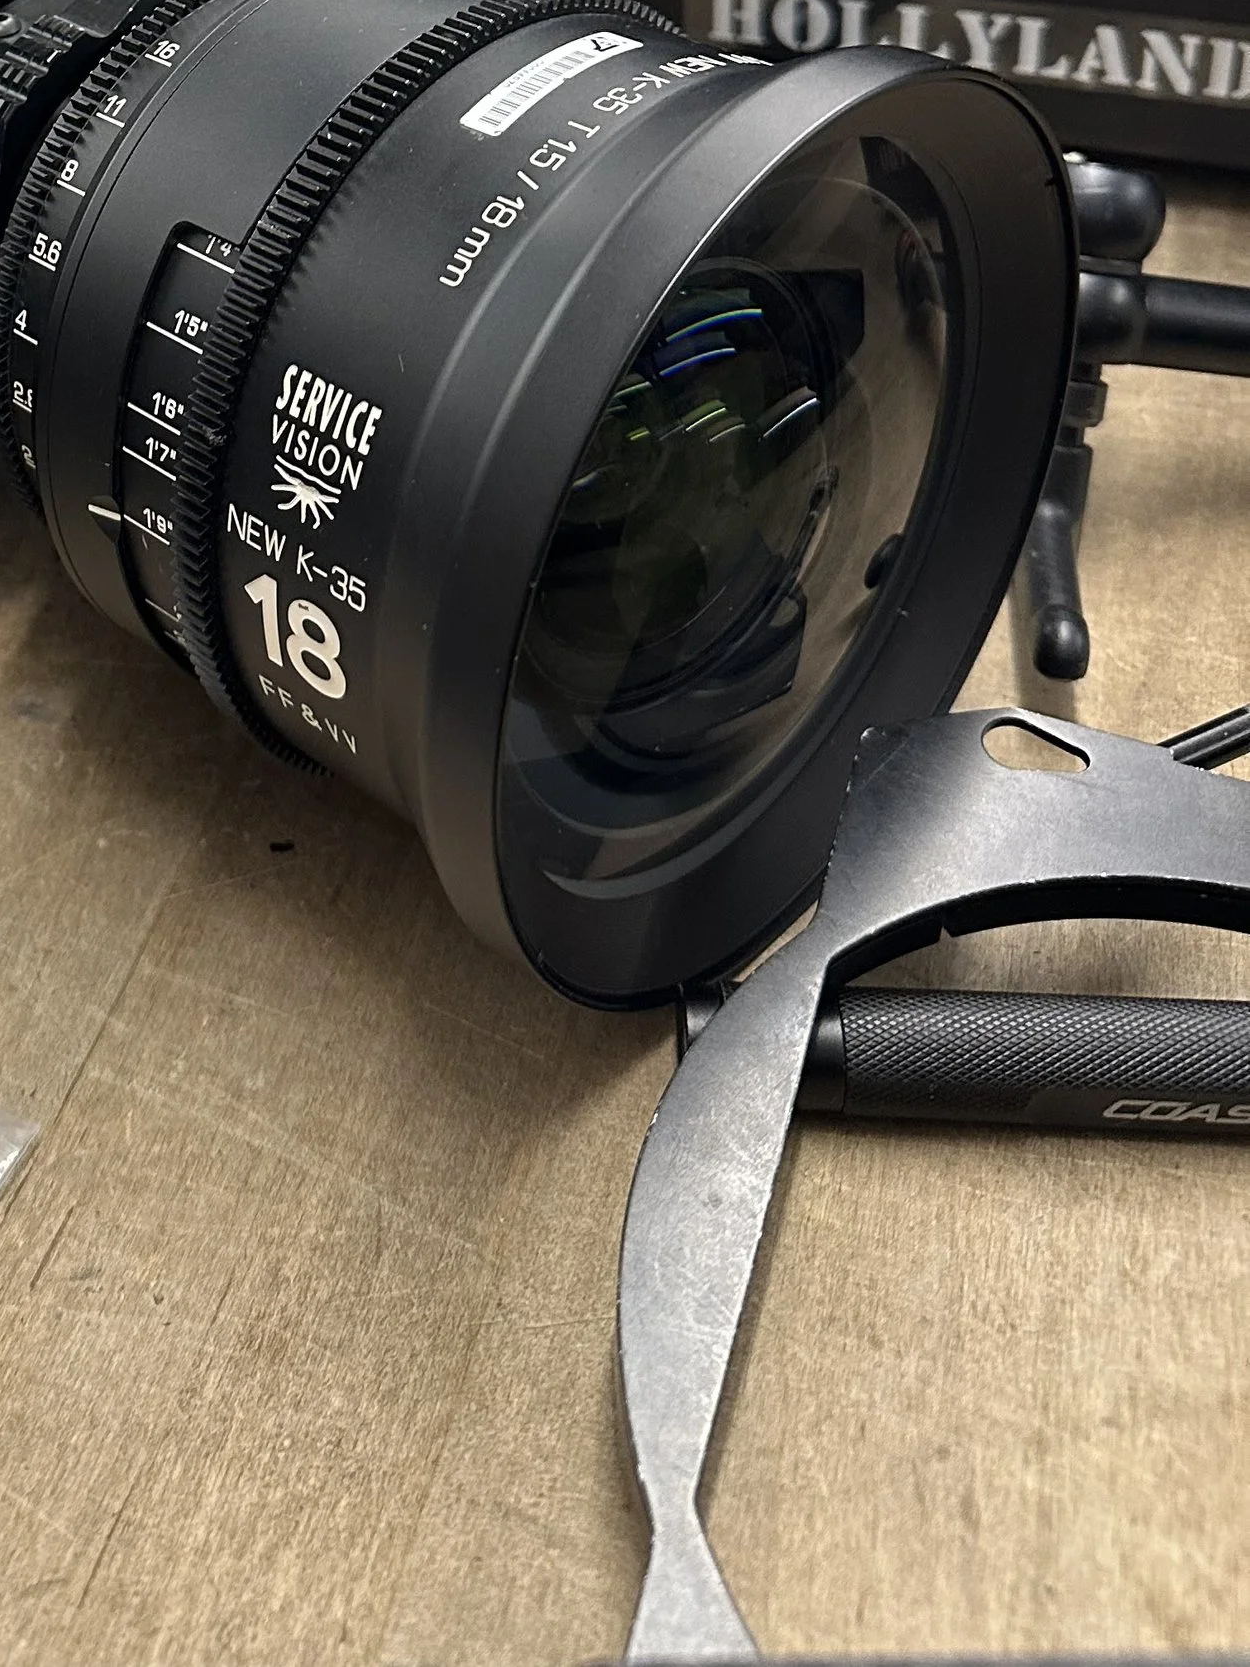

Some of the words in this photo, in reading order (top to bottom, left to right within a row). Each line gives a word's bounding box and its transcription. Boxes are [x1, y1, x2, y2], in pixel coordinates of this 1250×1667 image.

[152, 40, 180, 60] 16
[658, 54, 727, 78] NEW
[103, 95, 127, 117] 11
[592, 72, 671, 115] K-35
[567, 120, 601, 139] T
[529, 138, 577, 171] 1.5
[60, 159, 79, 182] 8
[32, 233, 63, 264] 5.6
[15, 309, 27, 331] 4
[174, 309, 209, 337] 1'5"
[152, 392, 185, 420] 1'6"
[275, 364, 383, 455] SERVICE
[145, 437, 177, 462] 1'7"
[272, 414, 364, 491] VISION
[227, 503, 287, 562] NEW
[296, 544, 366, 613] K-35
[244, 573, 347, 700] 18
[258, 674, 294, 708] FF
[301, 703, 323, 731] &
